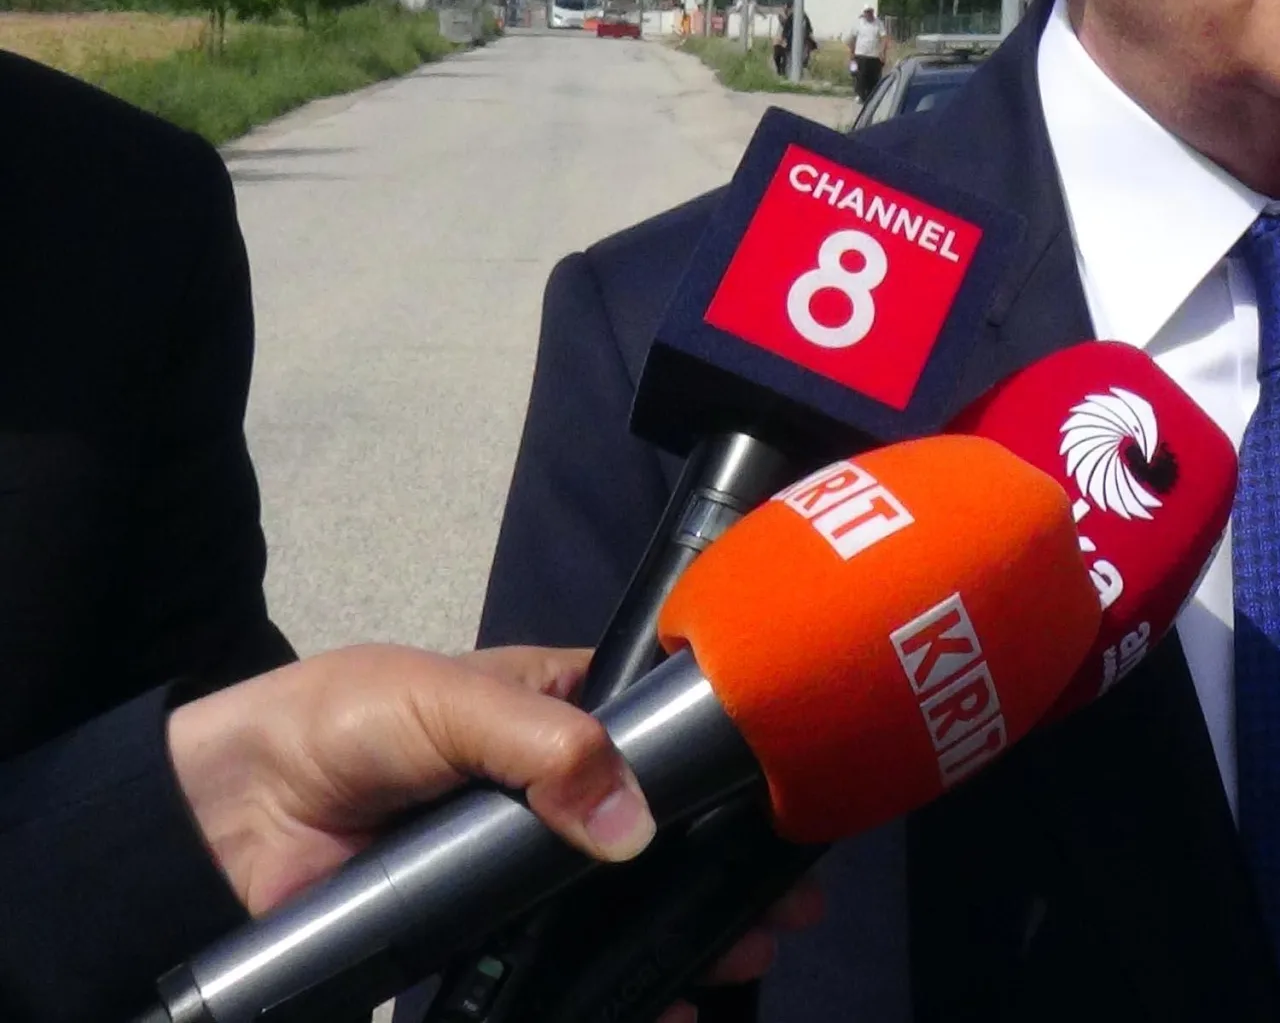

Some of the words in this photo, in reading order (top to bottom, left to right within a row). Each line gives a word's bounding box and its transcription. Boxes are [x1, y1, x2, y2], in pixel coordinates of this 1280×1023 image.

[788, 163, 960, 263] CHANNEL
[787, 229, 888, 349] 8
[897, 600, 1005, 780] KRT
